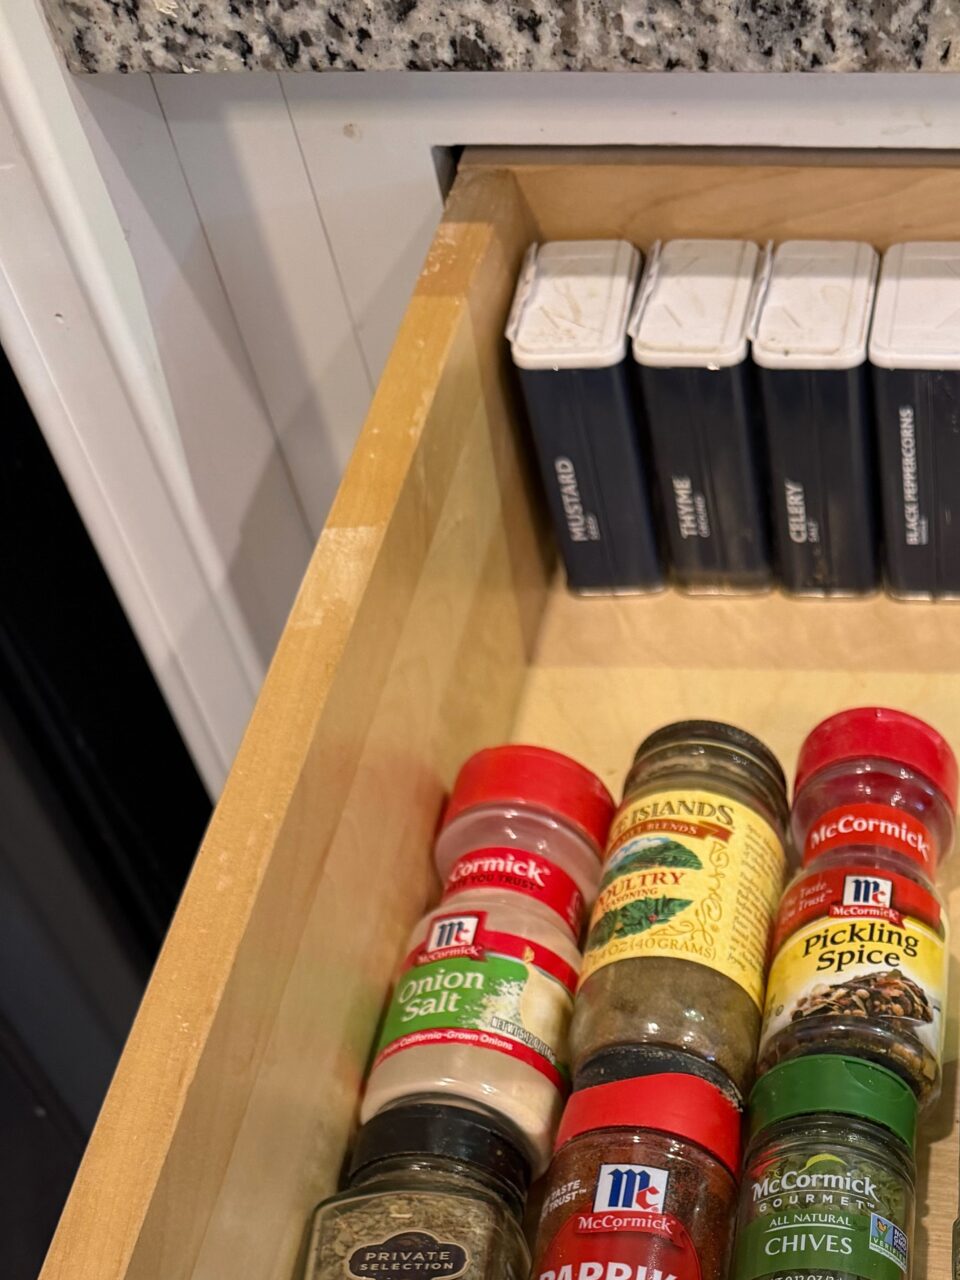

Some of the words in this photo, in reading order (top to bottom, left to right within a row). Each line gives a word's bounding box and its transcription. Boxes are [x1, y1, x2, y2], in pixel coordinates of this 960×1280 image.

[899, 406, 918, 502] PEPPERCORNS
[554, 456, 589, 541] MUSTARD
[672, 475, 697, 539] THYME
[785, 479, 807, 543] CELERY
[904, 502, 920, 546] BLACK
[632, 800, 734, 826] ISLANDS
[810, 815, 931, 862] McCormick
[832, 905, 898, 921] McCormick
[802, 922, 919, 958] Pickling
[816, 944, 900, 973] Spice
[399, 968, 485, 1006] Onion
[402, 990, 463, 1024] Salt
[480, 1034, 513, 1050] Onions
[752, 1171, 880, 1202] McCormick
[759, 1194, 865, 1213] GOURMET
[578, 1215, 673, 1234] McCormick
[769, 1215, 790, 1228] ALL
[793, 1213, 852, 1227] NATURAL
[365, 1251, 451, 1262] PRIVATE
[765, 1233, 853, 1256] CHIVES
[360, 1261, 454, 1271] SELECTION
